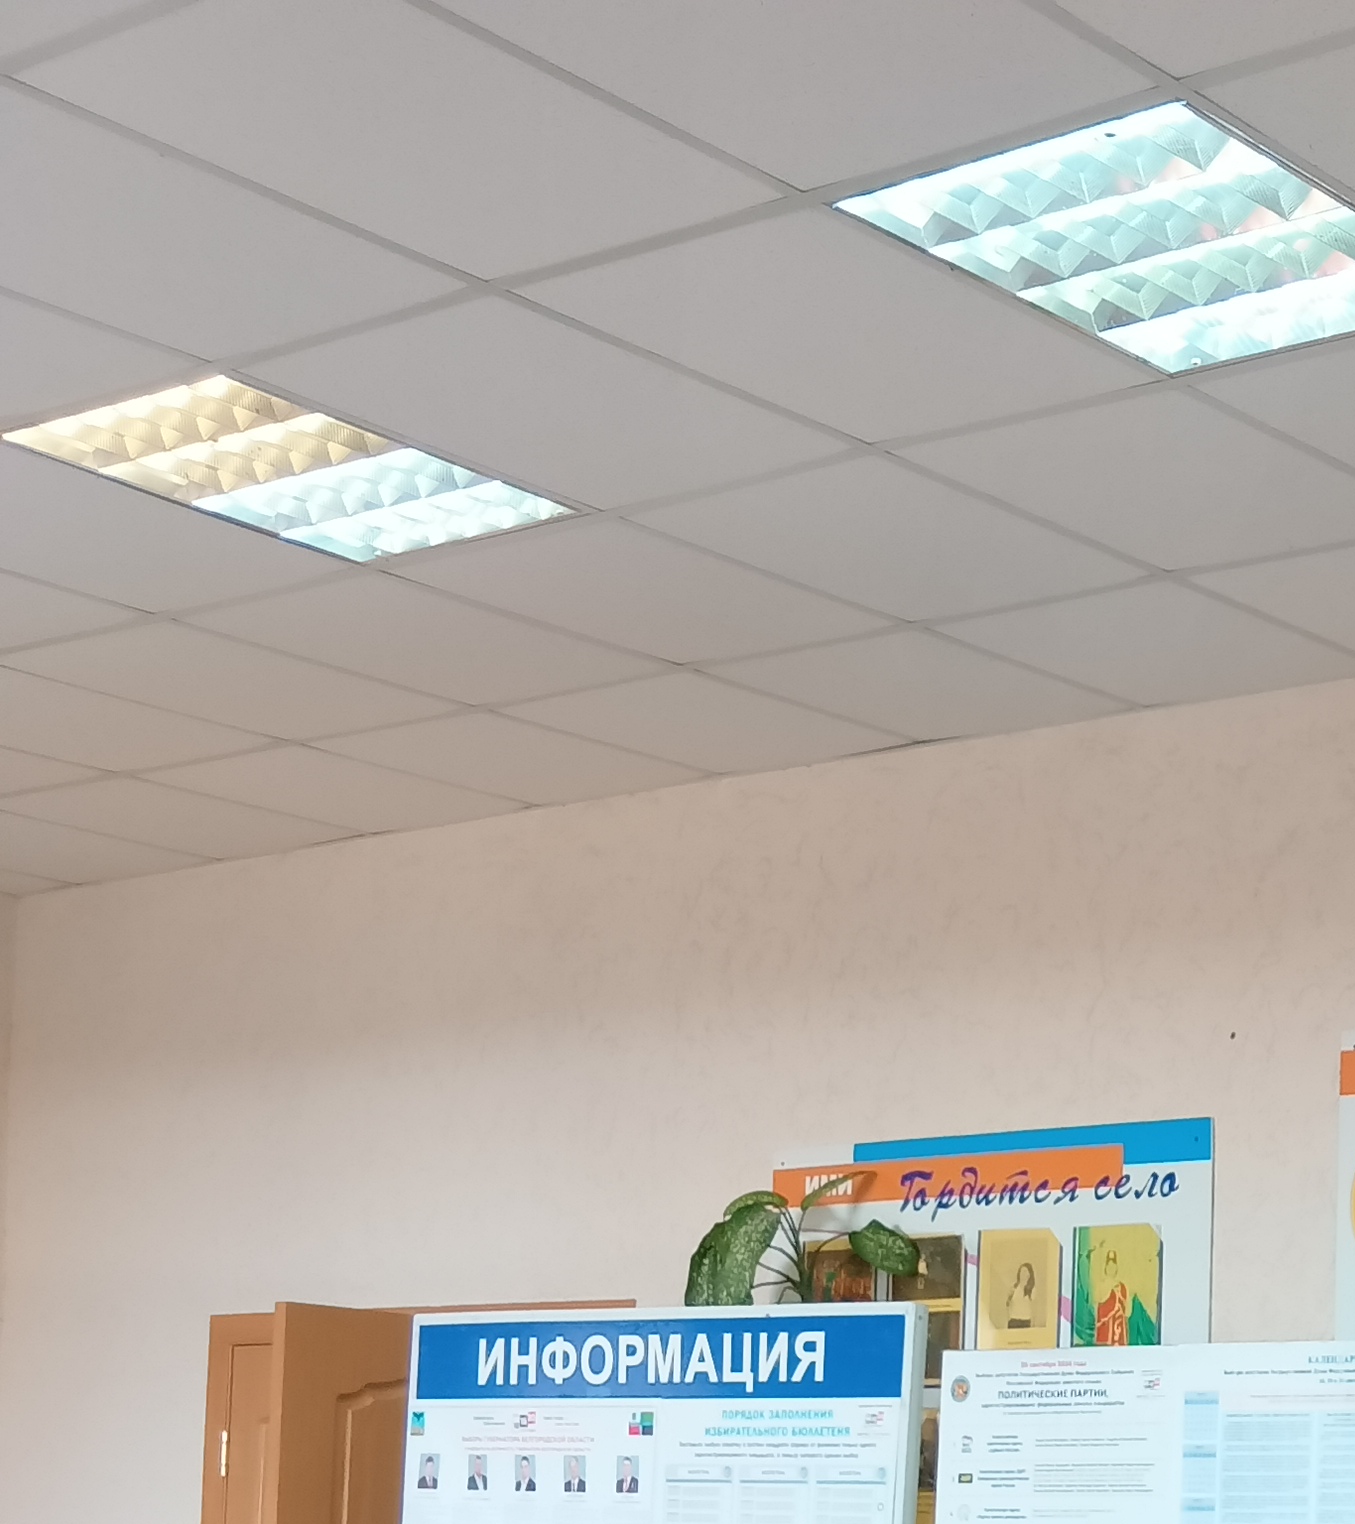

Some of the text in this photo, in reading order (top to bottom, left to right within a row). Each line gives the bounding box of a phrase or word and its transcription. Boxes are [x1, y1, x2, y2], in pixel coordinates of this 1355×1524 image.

[899, 1166, 1079, 1221] Гордится
[1093, 1171, 1179, 1200] село
[476, 1330, 826, 1392] ИНФОРМАЦИЯ
[998, 1389, 1068, 1399] ПОЛИТИЧЕСКИЕ
[721, 1410, 834, 1420] ПОРЯДОК ЗАПОЛНЕНИЯ
[704, 1427, 789, 1436] ИЗБИРАТЕЛЬНОГО
